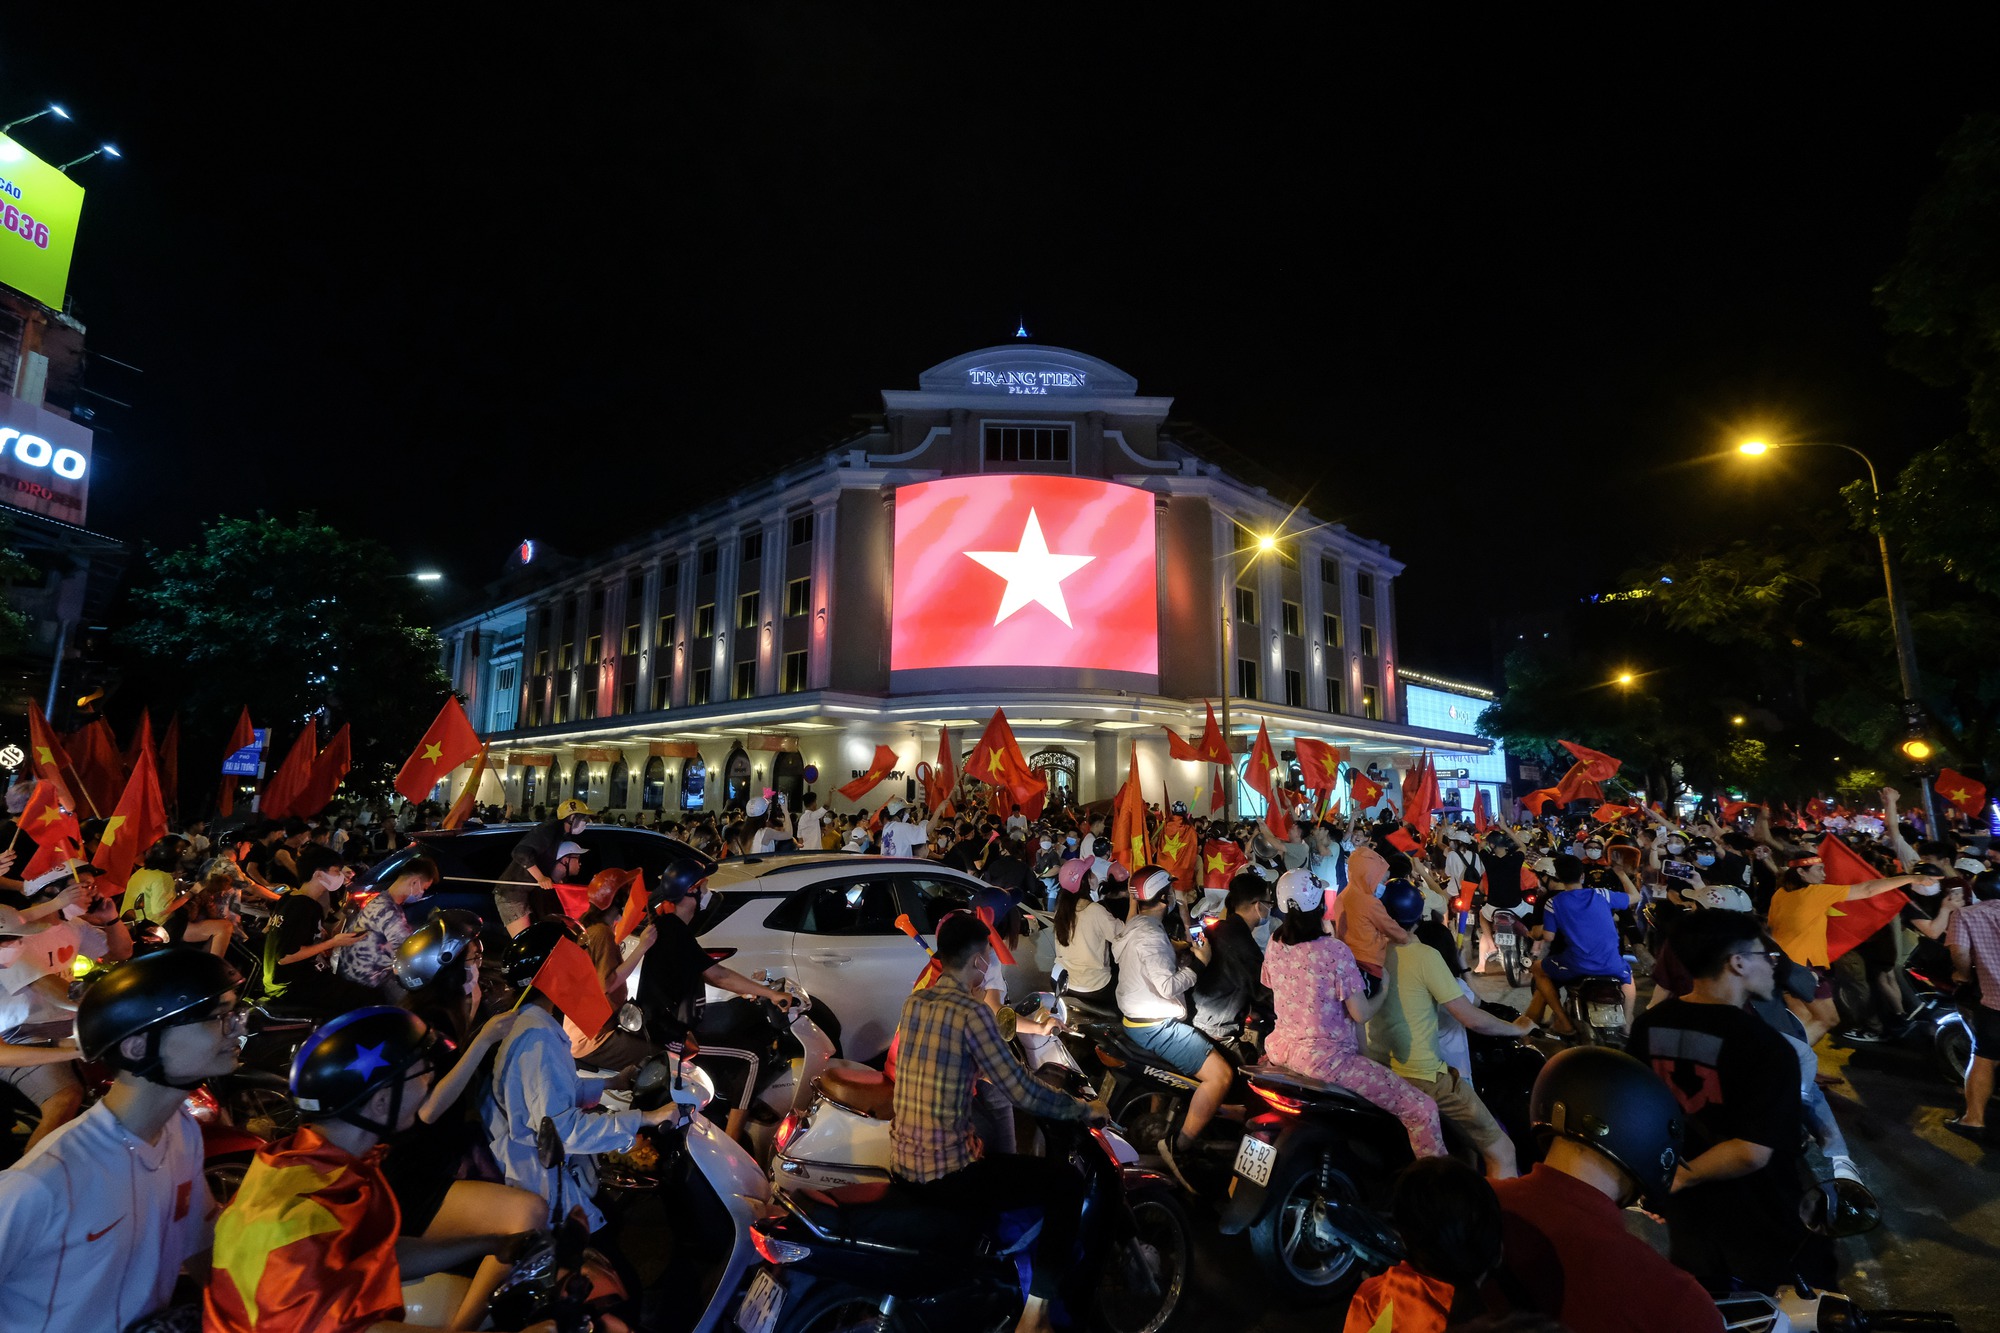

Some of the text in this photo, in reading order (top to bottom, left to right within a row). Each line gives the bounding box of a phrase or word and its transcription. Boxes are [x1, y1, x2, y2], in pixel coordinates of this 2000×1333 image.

[969, 370, 1086, 387] TRANG TIEN
[1008, 386, 1048, 395] PLAZA
[1457, 769, 1466, 778] P
